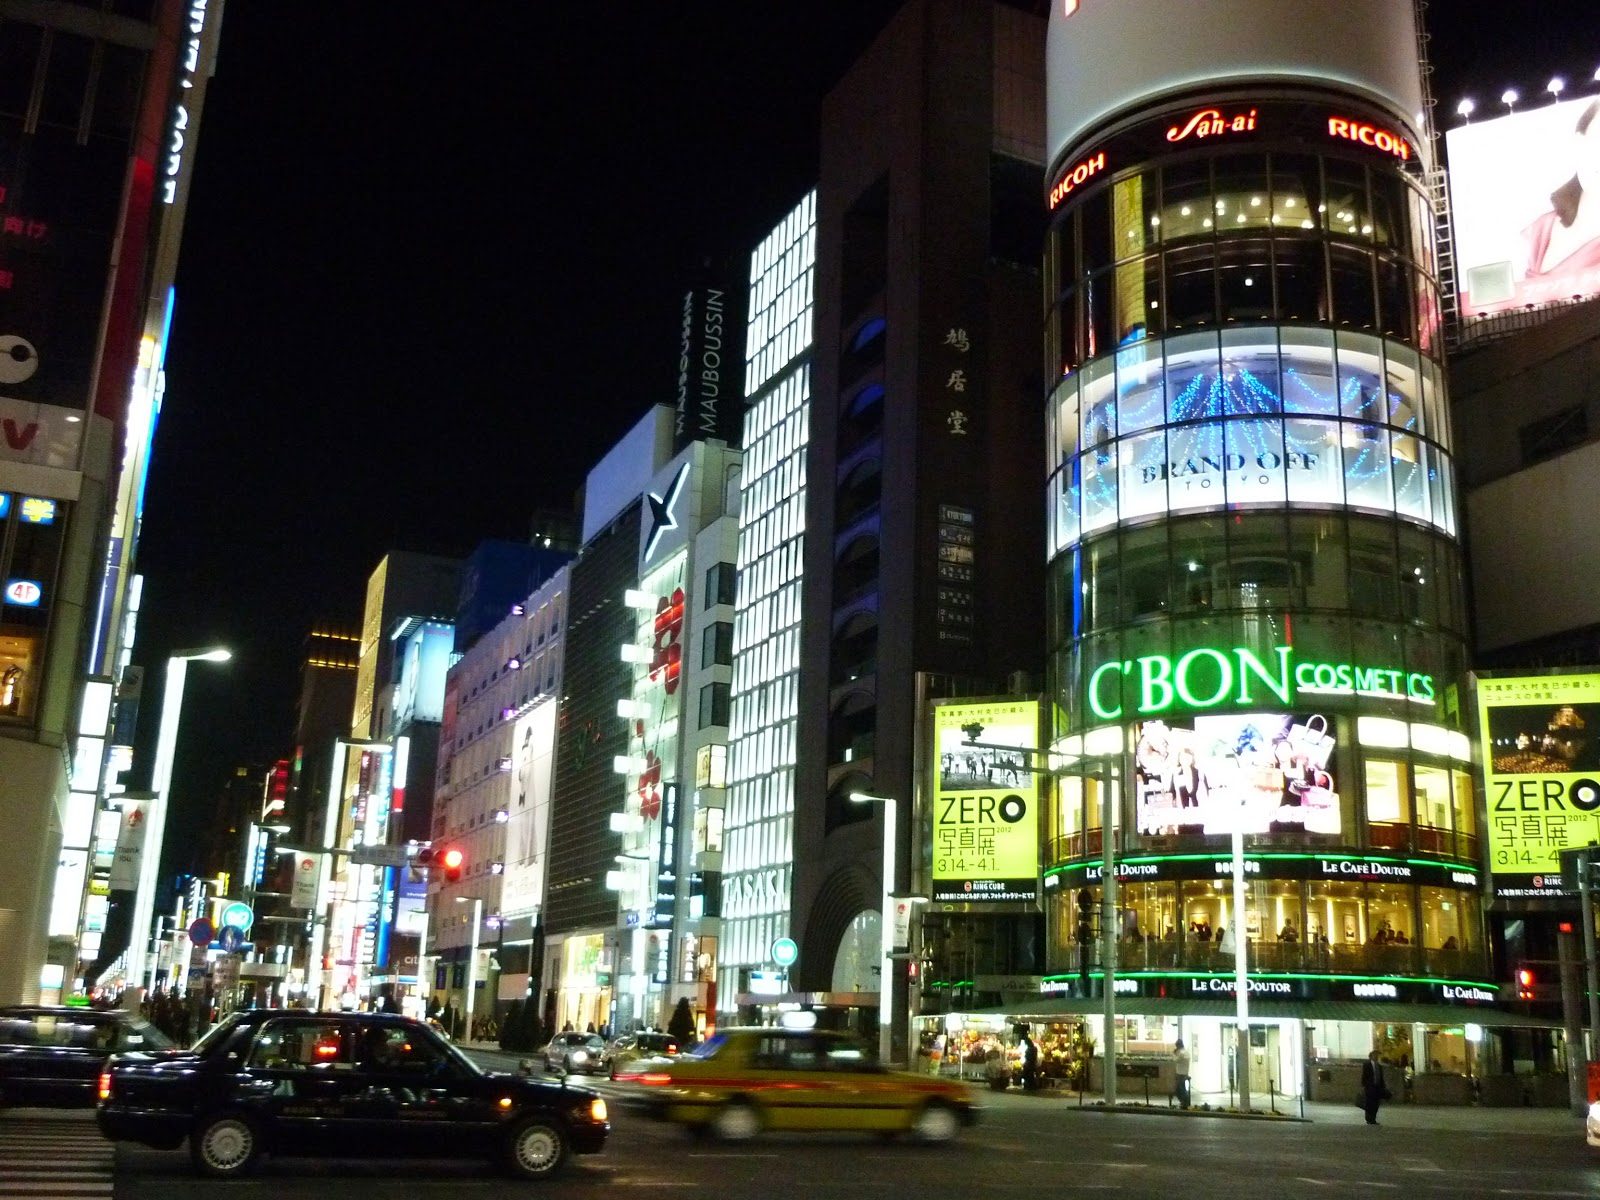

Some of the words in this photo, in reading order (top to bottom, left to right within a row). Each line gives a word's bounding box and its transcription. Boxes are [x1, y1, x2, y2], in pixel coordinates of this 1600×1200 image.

[1166, 109, 1257, 141] San-ai
[1328, 118, 1409, 160] RICOH
[1050, 153, 1104, 209] RICOH
[699, 288, 725, 433] MAUBOUSSIN
[943, 328, 970, 435] 鳩居堂
[1142, 454, 1246, 484] BRAND
[1256, 452, 1320, 471] OFF
[1186, 475, 1269, 491] TOYO
[1089, 646, 1293, 719] C'BON
[1295, 664, 1435, 702] COSMETICS
[939, 794, 1027, 824] ZERO
[1493, 778, 1600, 812] ZERO
[938, 827, 996, 856] 写真展
[1495, 814, 1569, 847] 写真展
[1120, 863, 1158, 876] DOUTOR
[1371, 862, 1411, 877] DOUTOR
[721, 868, 786, 904] TASAKI
[973, 882, 988, 890] RING
